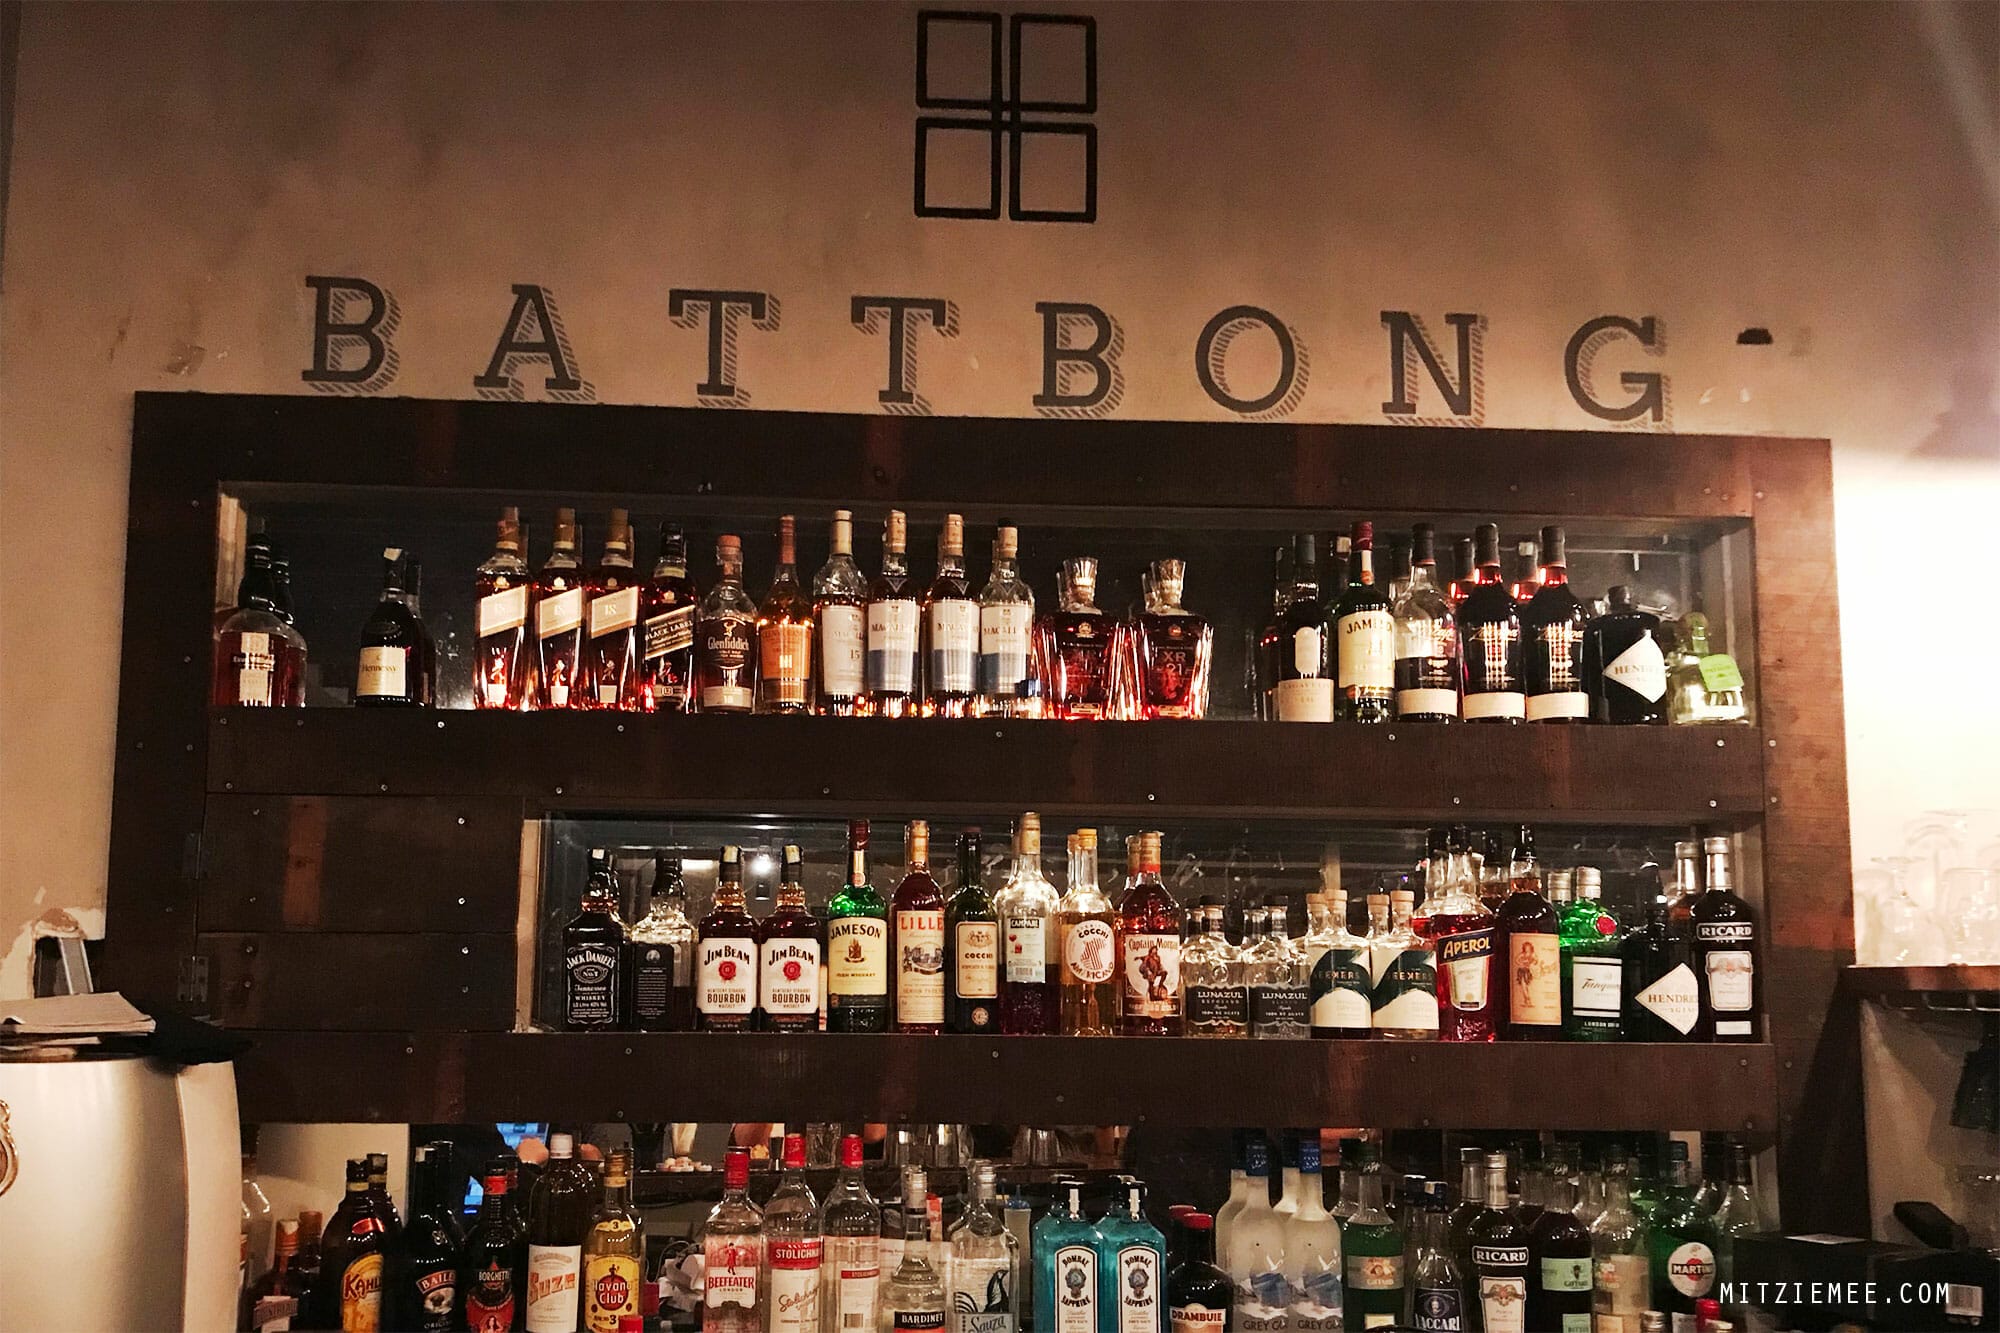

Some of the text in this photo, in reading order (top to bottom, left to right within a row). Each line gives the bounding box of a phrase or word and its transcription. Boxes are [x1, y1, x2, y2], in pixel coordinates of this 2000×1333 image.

[301, 275, 1672, 434] BATTBONG
[645, 629, 669, 640] BLACK
[670, 620, 693, 632] LABEL
[708, 637, 750, 651] Glenfiddich
[850, 648, 861, 660] 15
[1163, 651, 1187, 663] XR
[361, 663, 397, 675] Hennessy
[1166, 663, 1183, 676] 21
[830, 923, 881, 939] JAMESON
[1078, 928, 1109, 939] COCCHI
[1701, 926, 1752, 937] RICARD
[1443, 937, 1491, 959] APEROL
[566, 950, 616, 970] JACK DANIEL'S
[704, 945, 750, 966] JIM BEAM
[769, 945, 814, 966] JIM BEAM
[707, 993, 746, 1004] BOURBON
[772, 993, 811, 1004] BOURBON
[1197, 991, 1244, 999] LUNAZUL
[1261, 992, 1308, 1000] LUNAZUL
[612, 1221, 619, 1230] 3
[1062, 1255, 1090, 1268] BOMBAY
[1124, 1255, 1153, 1268] BOMBAY
[1475, 1250, 1527, 1262] RICARD
[708, 1276, 755, 1289] BEEFEATER
[599, 1294, 625, 1304] Club
[1060, 1295, 1092, 1308] SAPPHIRE
[1123, 1295, 1154, 1308] SAPPHIRE
[609, 1314, 617, 1325] 3
[901, 1312, 943, 1324] BARDINET
[1171, 1310, 1222, 1322] DRAMBUIE
[970, 1314, 1005, 1333] Sauza
[1243, 1319, 1269, 1331] GREY
[1297, 1319, 1323, 1330] GREY
